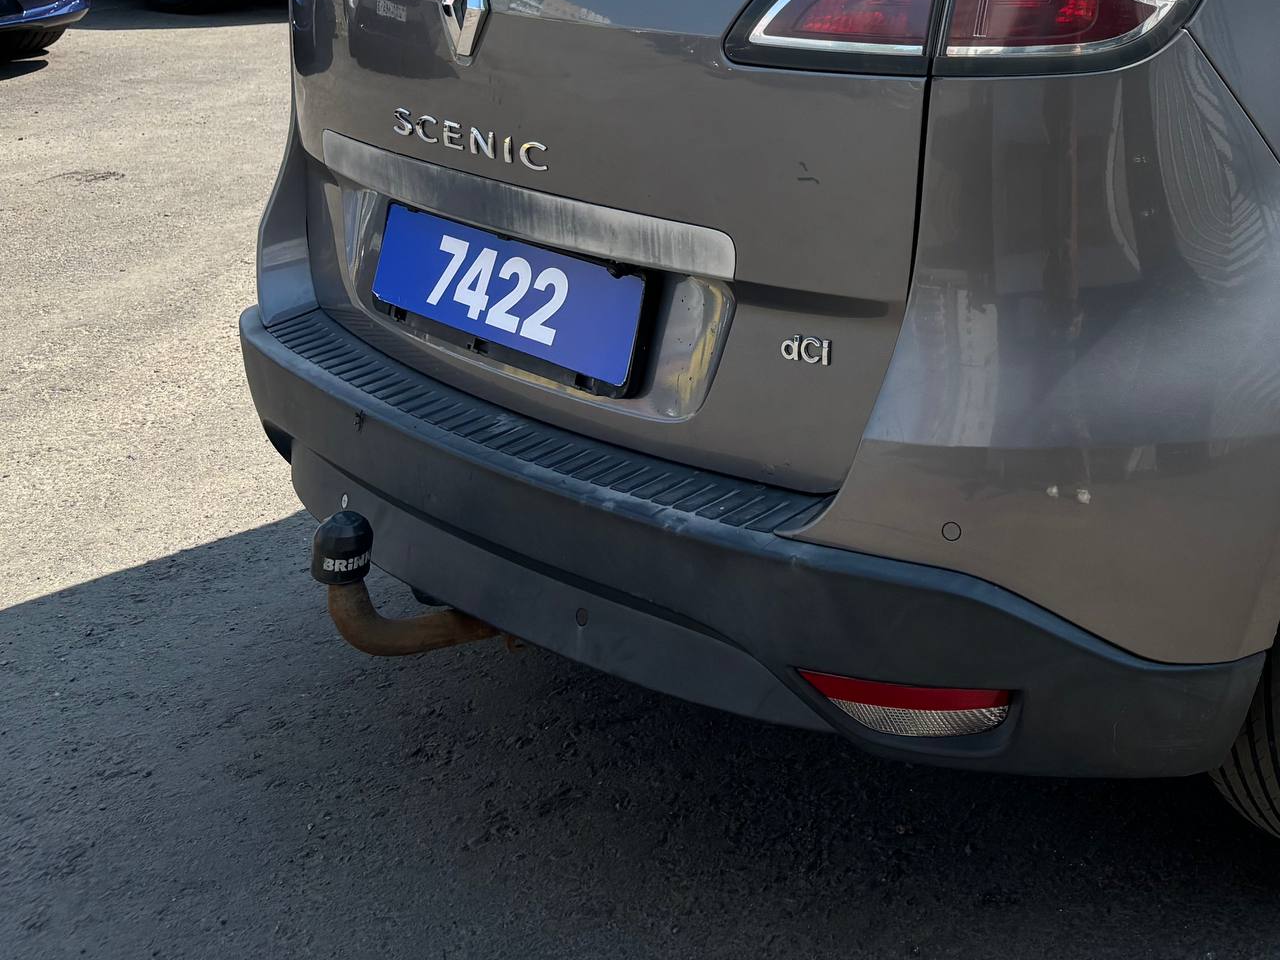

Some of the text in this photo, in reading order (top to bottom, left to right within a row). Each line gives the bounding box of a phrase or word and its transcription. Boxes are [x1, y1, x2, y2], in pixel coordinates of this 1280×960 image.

[393, 107, 549, 171] SCENIC
[426, 235, 569, 346] 7422
[780, 334, 832, 366] dCi
